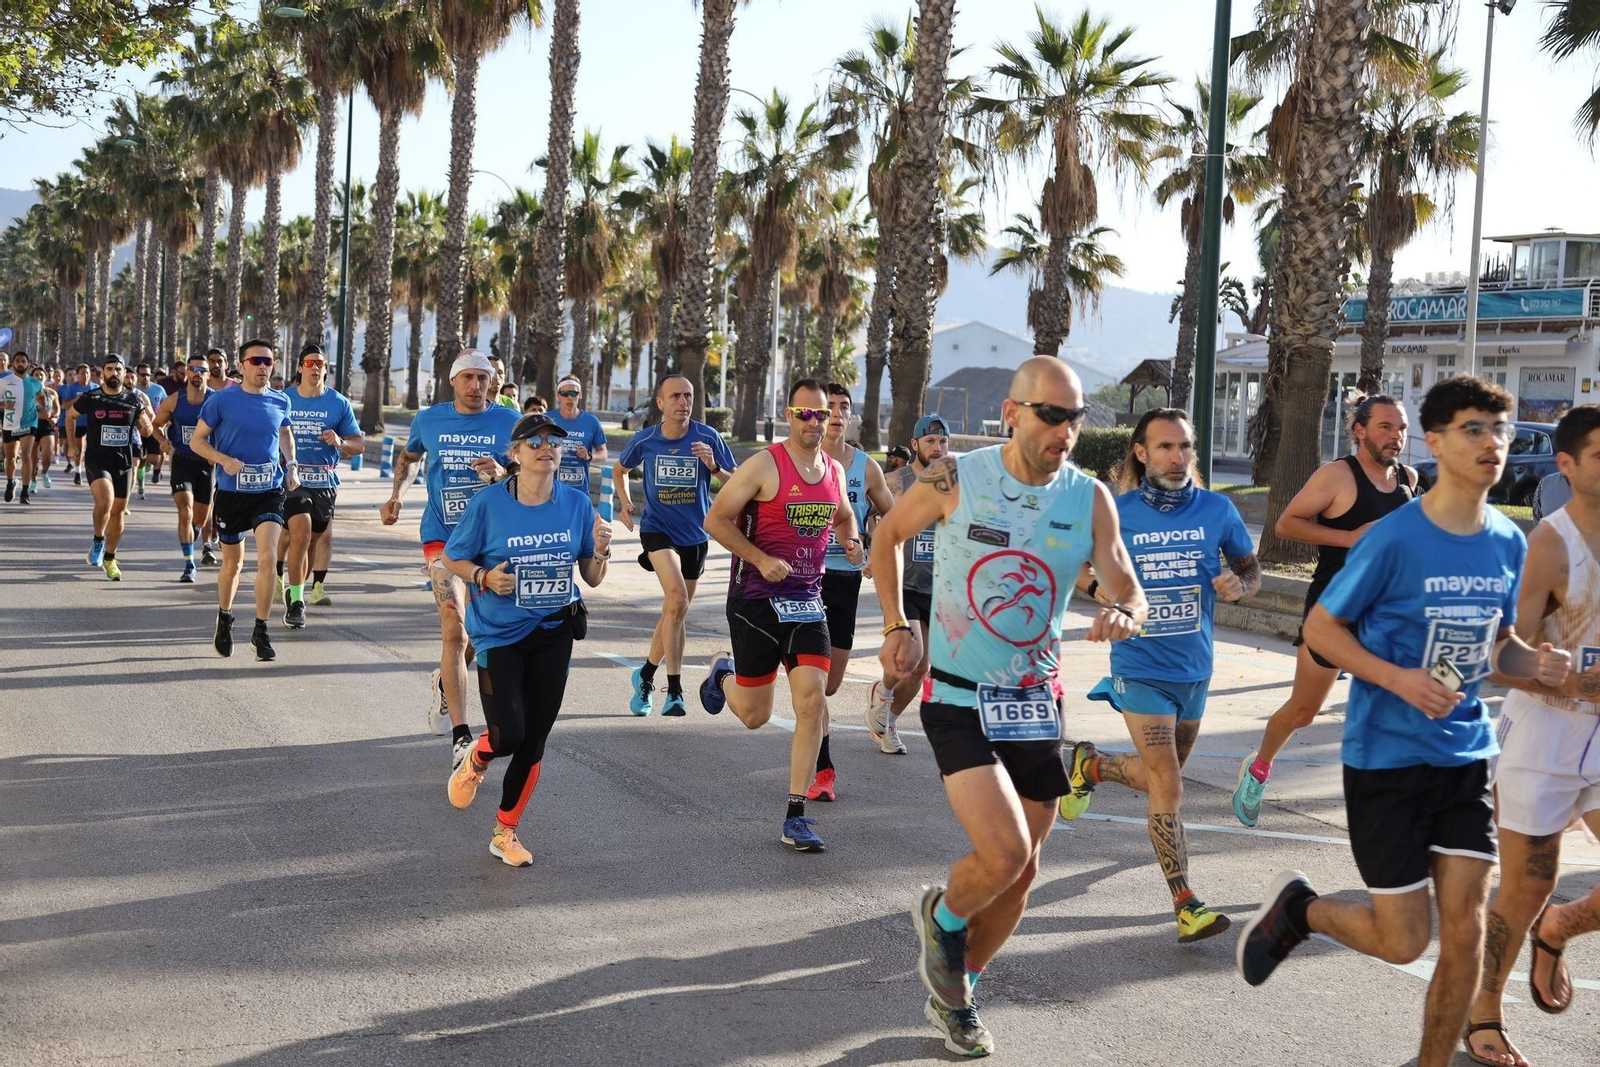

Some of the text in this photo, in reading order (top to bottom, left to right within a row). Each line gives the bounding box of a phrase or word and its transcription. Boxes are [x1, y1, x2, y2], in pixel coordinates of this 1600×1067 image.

[1390, 297, 1468, 320] ROCAMAR
[1391, 344, 1427, 354] ROCAMAR
[1528, 373, 1566, 383] ROCAMAR
[290, 410, 328, 418] mayoral
[438, 434, 496, 445] mayoral
[443, 456, 478, 464] MAK
[242, 474, 269, 482] 1817
[661, 467, 693, 477] 1922
[449, 500, 466, 511] 20
[788, 504, 837, 518] TRISPORT
[507, 528, 571, 548] mayoral
[1133, 526, 1205, 545] mayoral
[920, 542, 934, 551] 15
[1135, 550, 1202, 563] RUNNING
[1143, 560, 1197, 571] MAKES
[1143, 568, 1198, 580] FRIENDS
[523, 580, 567, 594] 1773
[1424, 575, 1507, 596] mayoral
[1147, 604, 1194, 620] 2042
[1440, 645, 1484, 662] 221
[991, 703, 1049, 721] 1669
